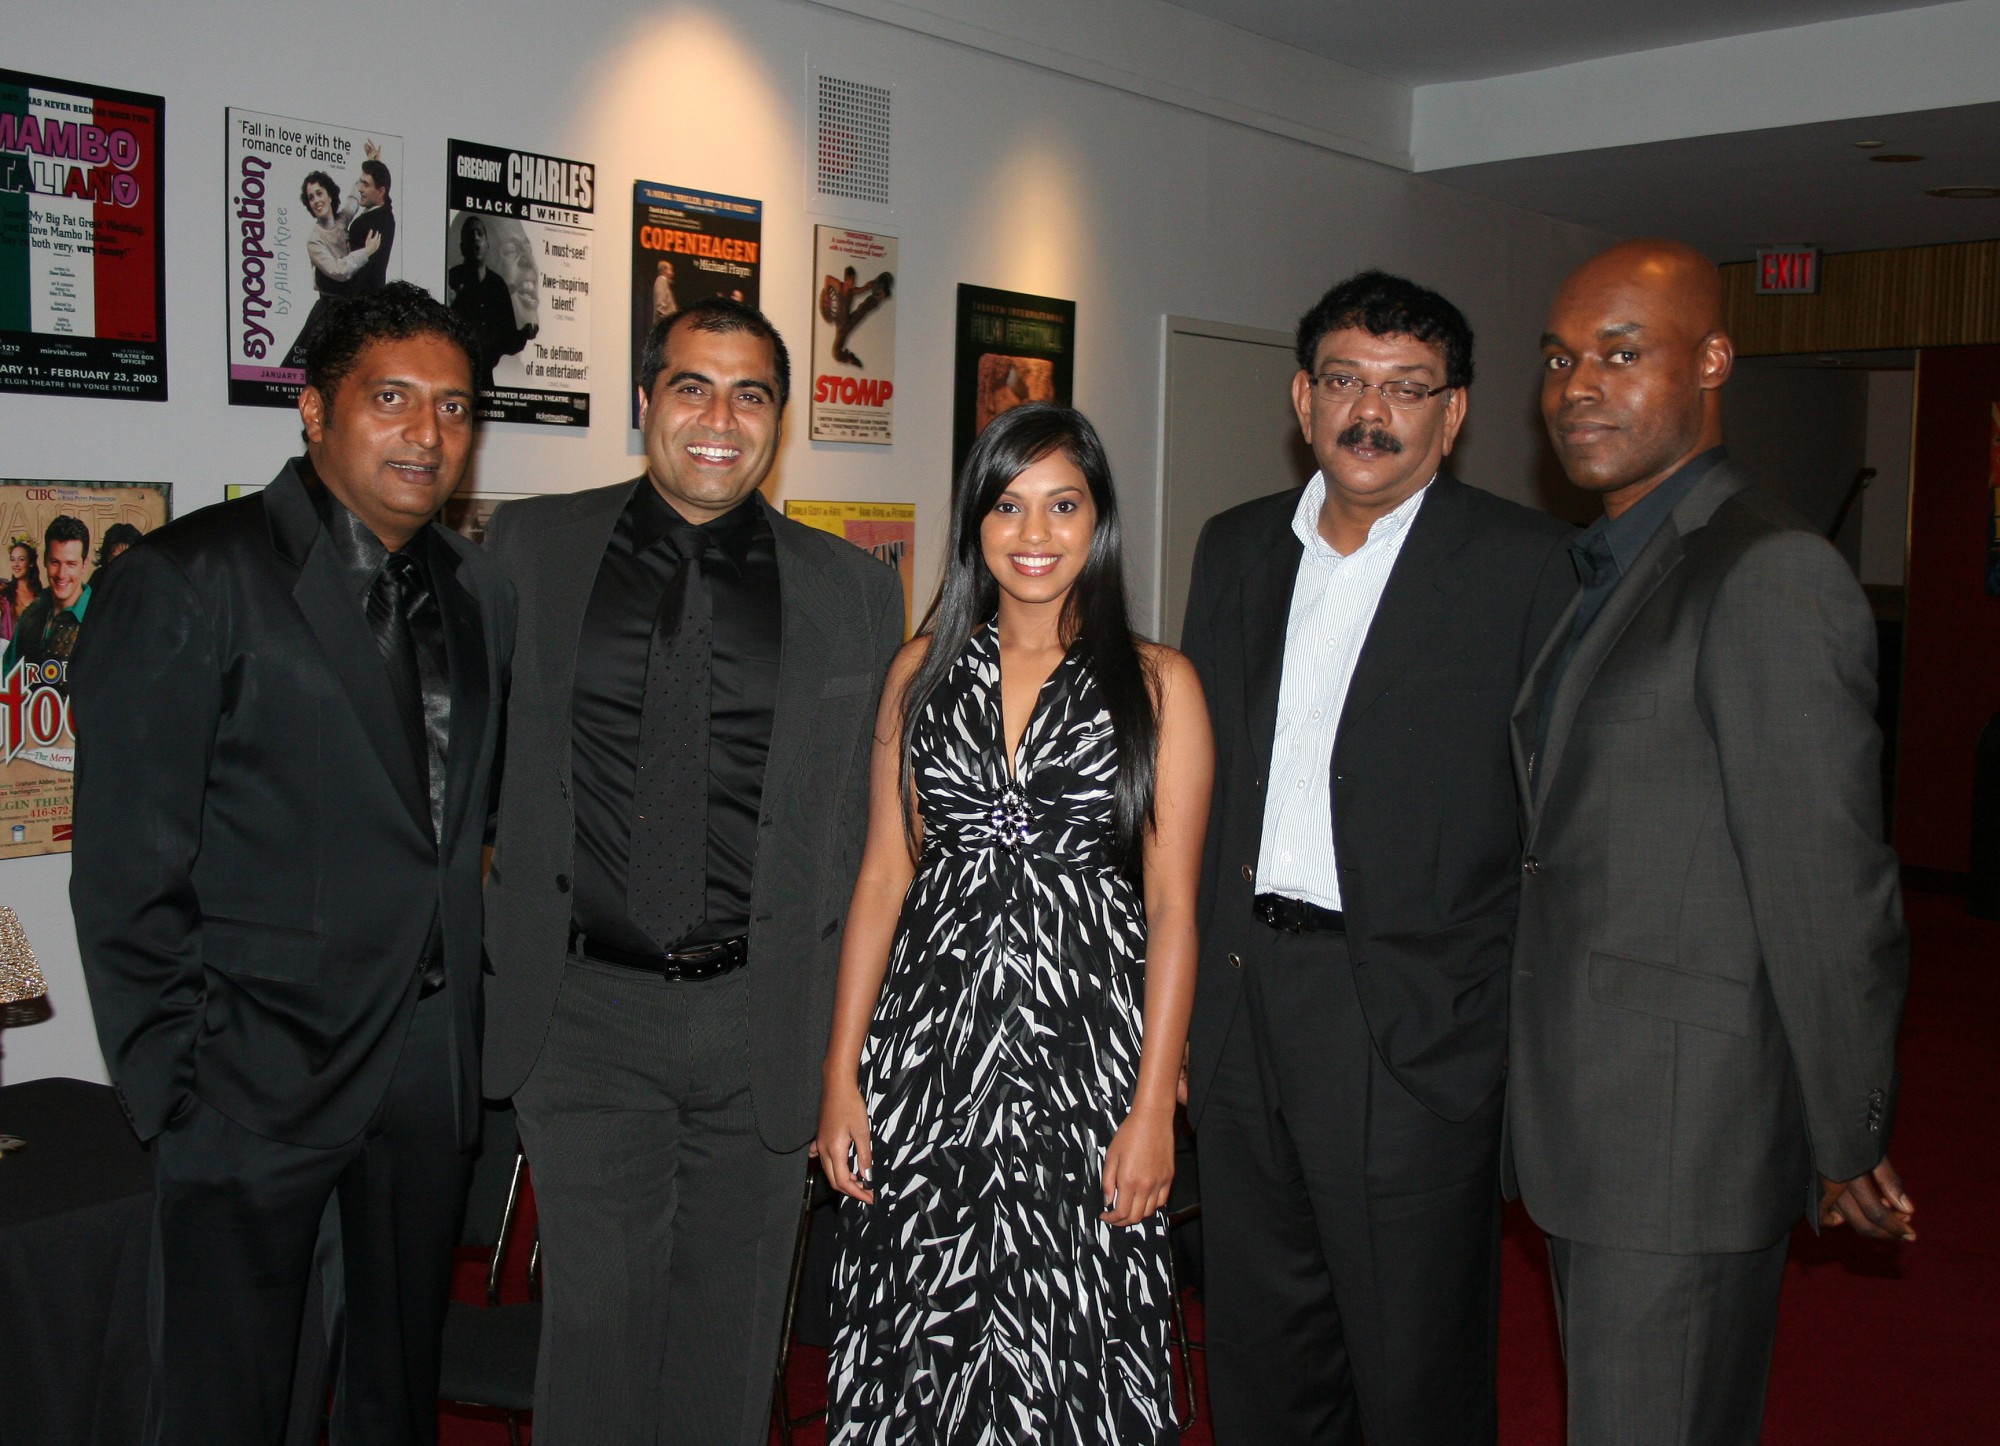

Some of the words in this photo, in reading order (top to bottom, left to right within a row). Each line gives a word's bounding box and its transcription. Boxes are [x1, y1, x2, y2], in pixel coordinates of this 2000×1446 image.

[44, 98, 71, 111] NEVER
[73, 105, 95, 115] BEEN
[265, 124, 275, 138] in
[279, 127, 302, 143] love
[305, 132, 330, 148] with
[333, 136, 351, 151] the
[242, 137, 292, 155] romance
[296, 145, 307, 158] of
[457, 155, 502, 183] GREGORY
[507, 152, 593, 209] CHARLES
[466, 196, 513, 214] BLACK
[521, 205, 529, 216] &
[536, 207, 579, 224] WHITE
[29, 211, 43, 223] My
[46, 212, 61, 227] Big
[63, 214, 77, 226] Fat
[274, 207, 291, 247] Knee
[29, 223, 48, 236] love
[51, 226, 82, 240] Mambo
[32, 236, 51, 249] both
[53, 242, 74, 254] very,
[77, 245, 95, 256] very
[640, 225, 759, 263] COPENHAGEN
[233, 155, 274, 360] syncopation
[274, 251, 292, 294] Allan
[699, 259, 728, 274] Michael
[729, 263, 752, 278] Frayn
[1762, 253, 1813, 289] EXIT
[274, 297, 292, 315] by
[40, 347, 87, 357] mirvish.com
[112, 352, 140, 360] THEATRE
[550, 345, 583, 362] definition
[121, 358, 146, 366] OFFICES
[526, 361, 533, 375] of
[535, 365, 544, 377] an
[28, 367, 39, 375] 11
[51, 368, 110, 381] FEBRUARY
[114, 372, 130, 383] 23,
[133, 374, 158, 384] 2003
[260, 371, 298, 380] JANUARY
[5, 378, 29, 386] ELGIN
[31, 379, 65, 388] THEATRE
[84, 383, 110, 391] YONGE
[112, 385, 141, 393] STREET
[813, 374, 893, 407] STOMP
[496, 391, 519, 399] WINTER
[519, 393, 543, 401] GARDEN
[544, 395, 569, 403] THEATRE
[26, 489, 56, 501] CIBC
[35, 751, 48, 761] The
[50, 753, 73, 764] Merry
[34, 795, 75, 807] THEA
